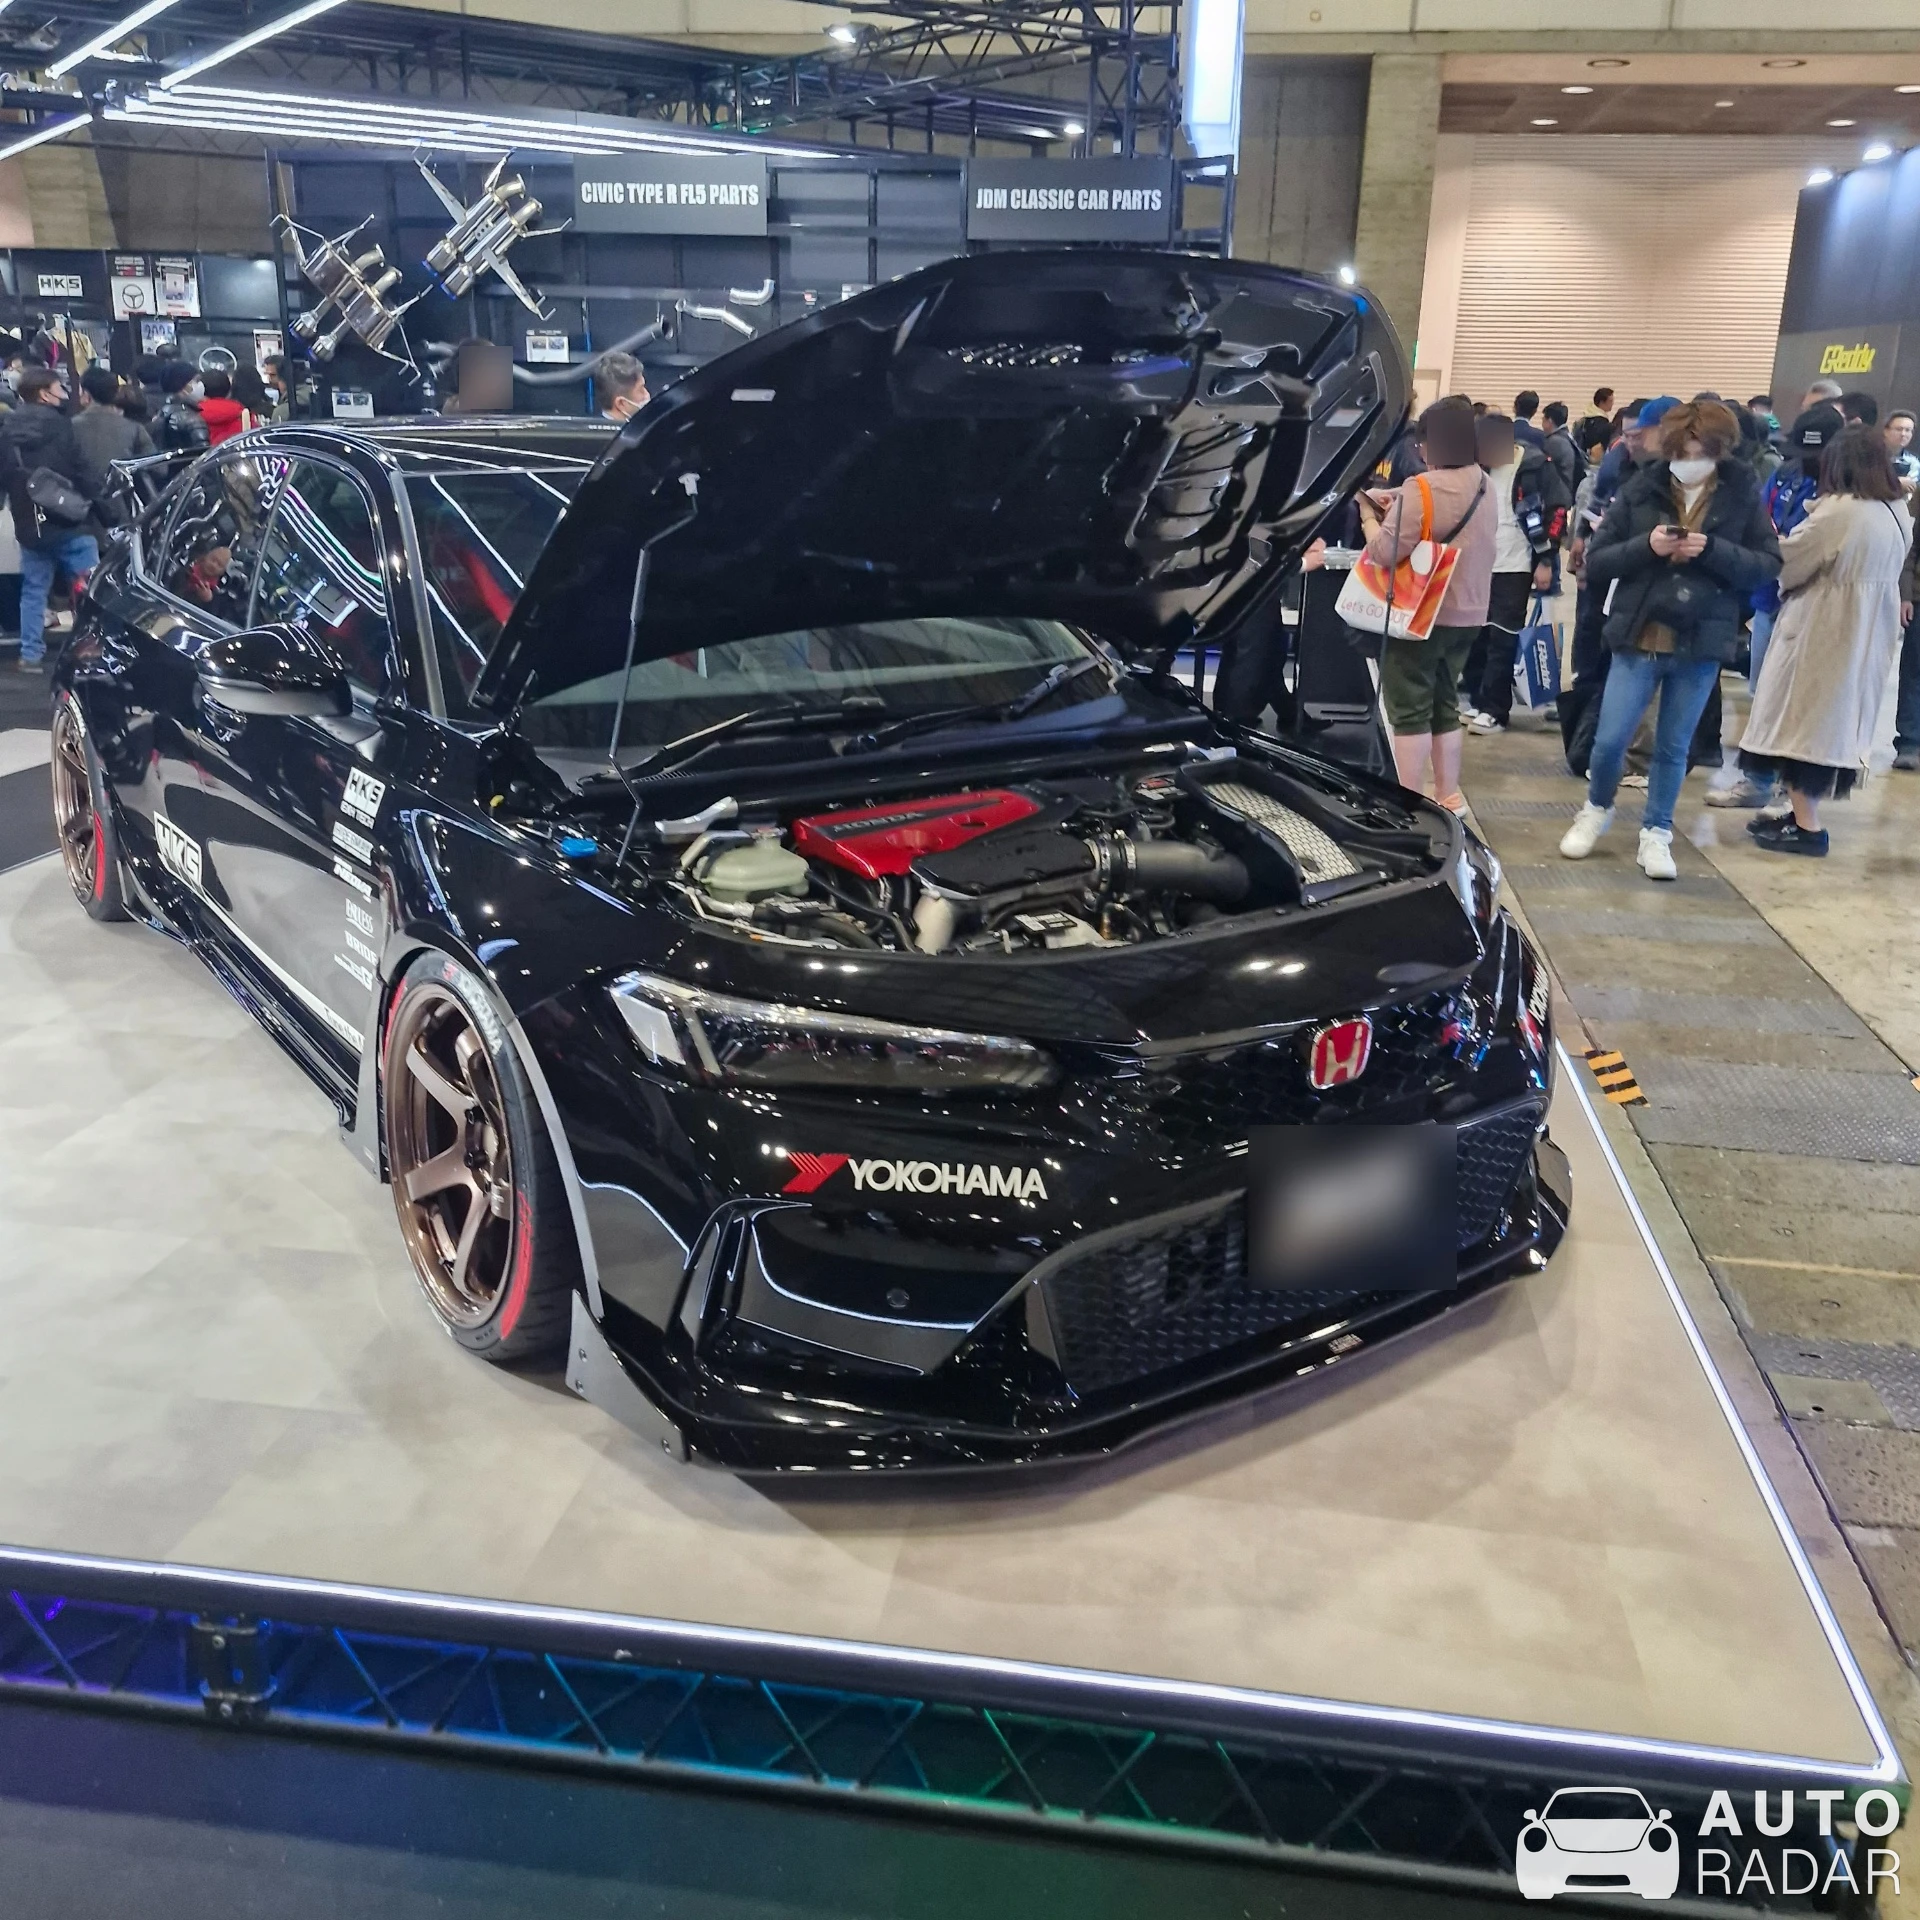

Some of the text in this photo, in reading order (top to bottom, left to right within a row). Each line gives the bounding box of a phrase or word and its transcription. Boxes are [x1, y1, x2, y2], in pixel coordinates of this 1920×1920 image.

[581, 182, 759, 206] CIVIC TYPE R FL5 PARTS
[976, 188, 1162, 211] JDM CLASSIC CAR PARTS
[39, 277, 81, 291] HKS
[1341, 598, 1364, 614] Let's
[1366, 604, 1384, 618] GO
[347, 771, 383, 806] HKS
[155, 814, 202, 890] HKS
[847, 1158, 1048, 1200] YOKOHAMA
